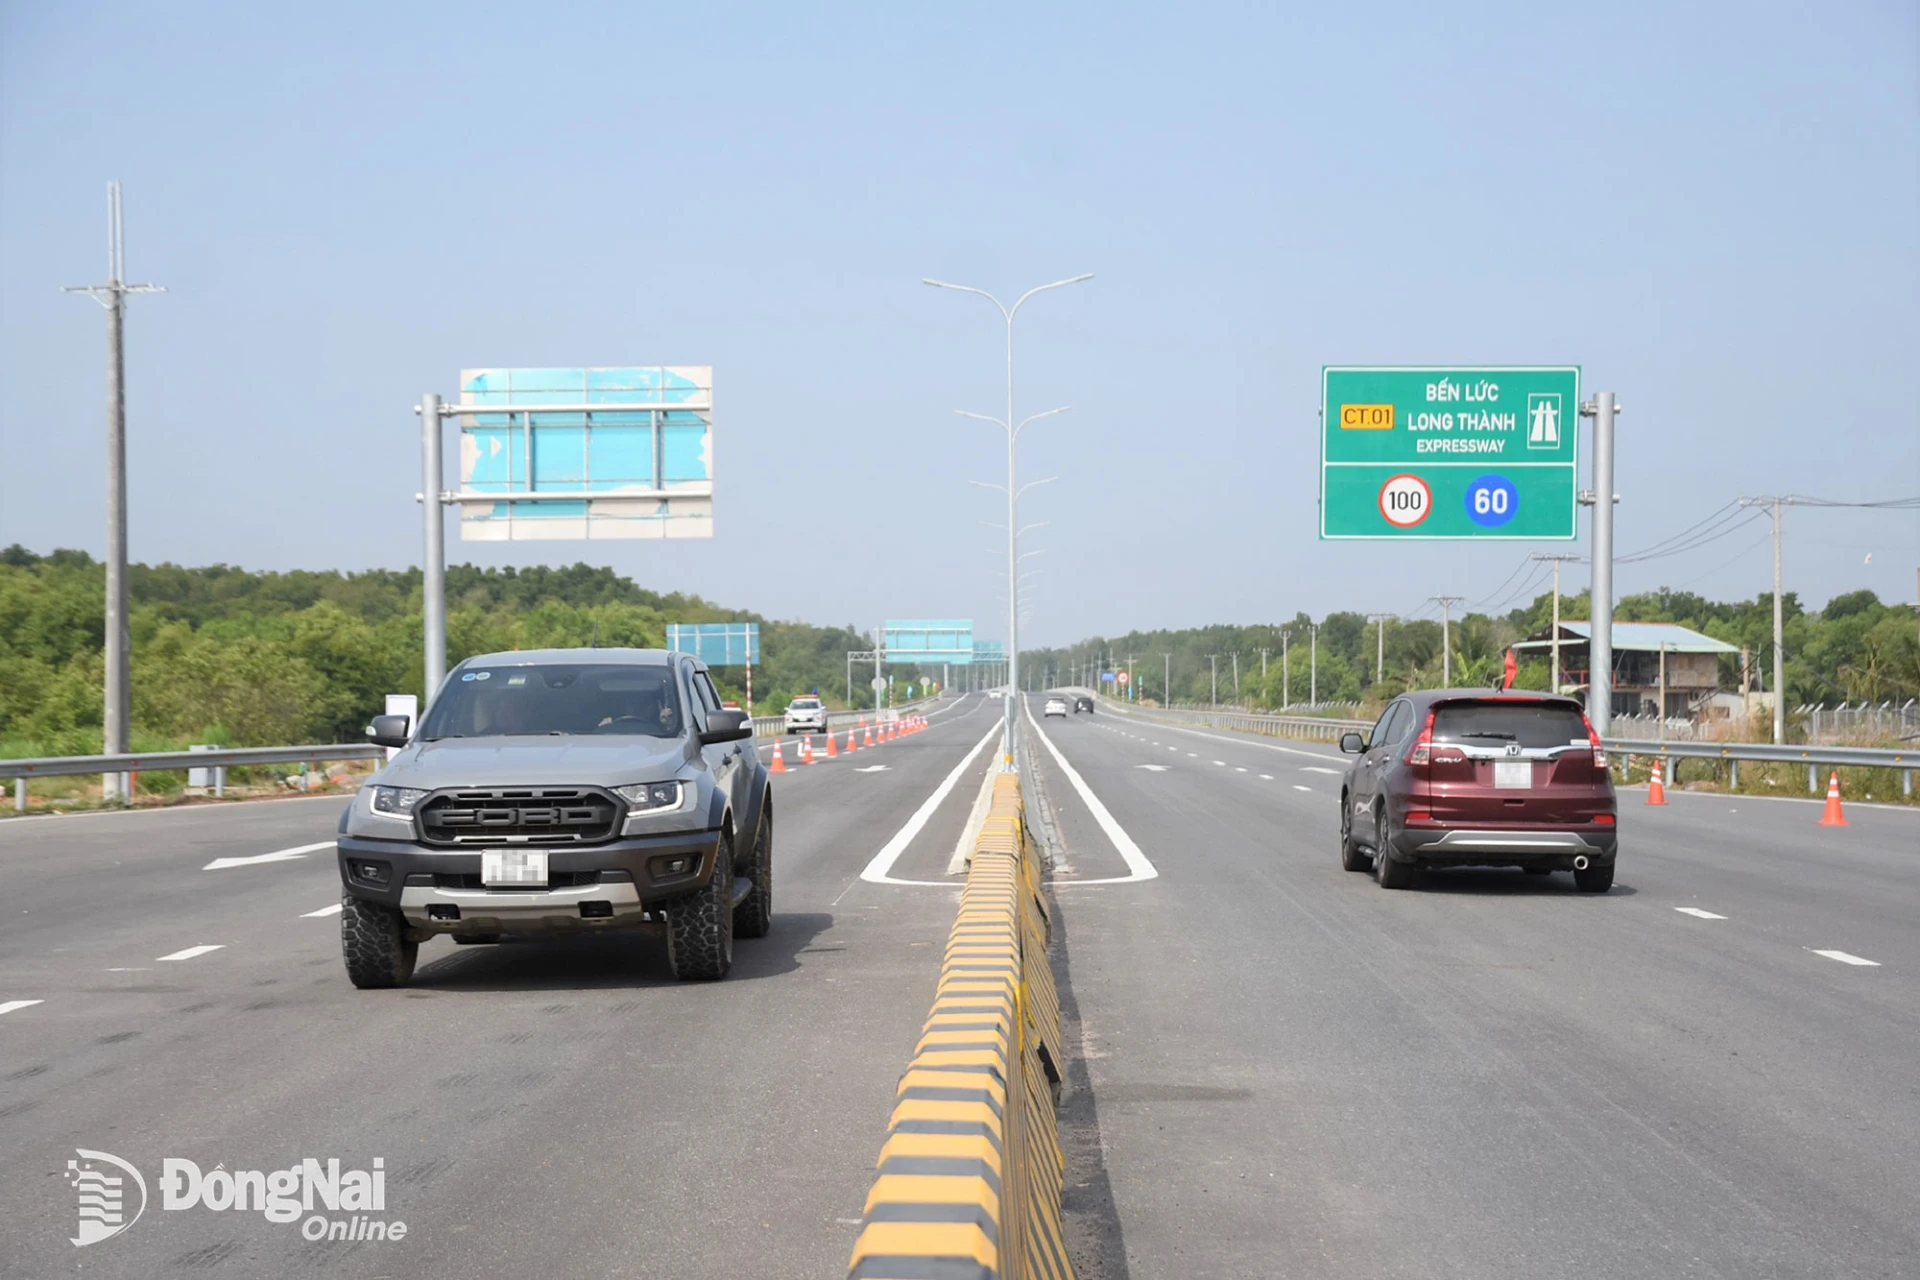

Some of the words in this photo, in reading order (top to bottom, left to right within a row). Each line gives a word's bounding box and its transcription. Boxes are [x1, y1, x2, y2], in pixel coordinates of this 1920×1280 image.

[1426, 377, 1460, 401] BẾN
[1465, 380, 1499, 401] LỨC
[1344, 408, 1391, 425] CT.01
[1407, 413, 1453, 431] LONG
[1457, 409, 1516, 431] THÀNH
[1416, 439, 1506, 453] EXPRESSWAY
[1389, 491, 1421, 510] 100
[1474, 488, 1508, 514] 60
[440, 806, 598, 826] FORD
